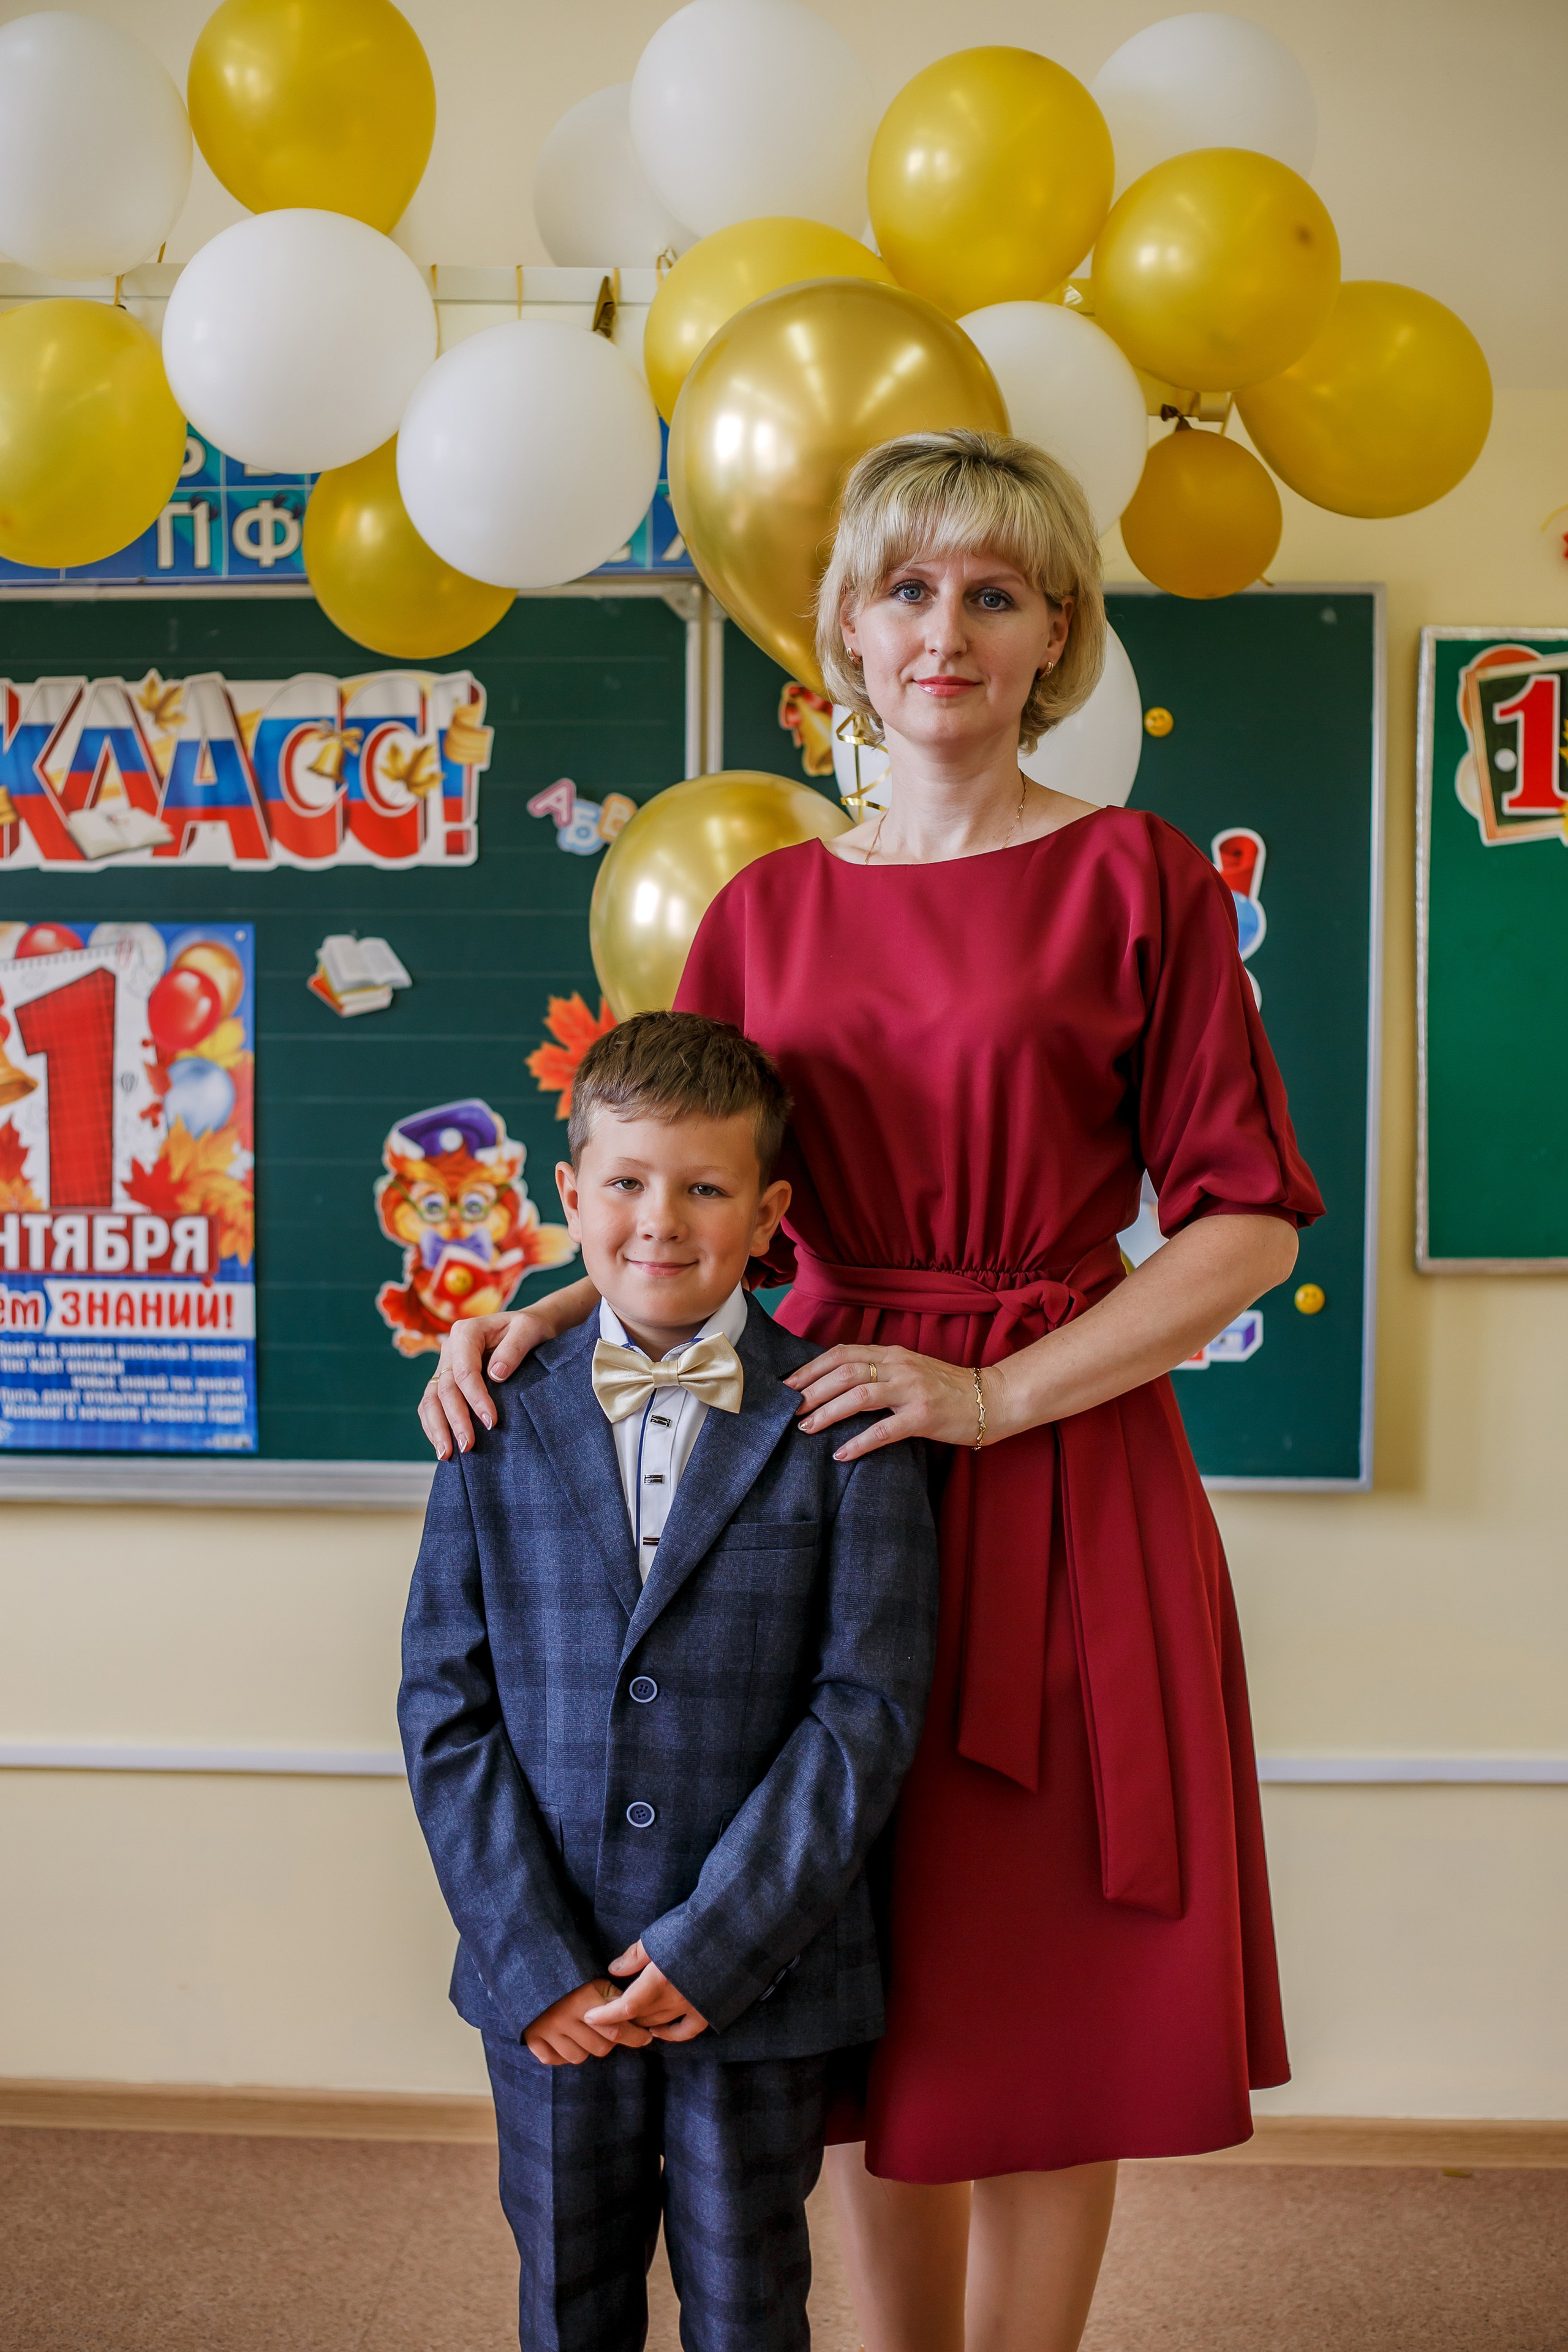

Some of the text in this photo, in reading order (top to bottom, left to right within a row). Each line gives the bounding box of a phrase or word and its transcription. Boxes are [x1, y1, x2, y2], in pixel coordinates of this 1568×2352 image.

[157, 499, 302, 569] П Ф
[0, 674, 481, 860] КЛАСС!
[1493, 674, 1568, 816] 1
[13, 966, 116, 1207] 1
[61, 1286, 233, 1330] ЗНАНИЙ!
